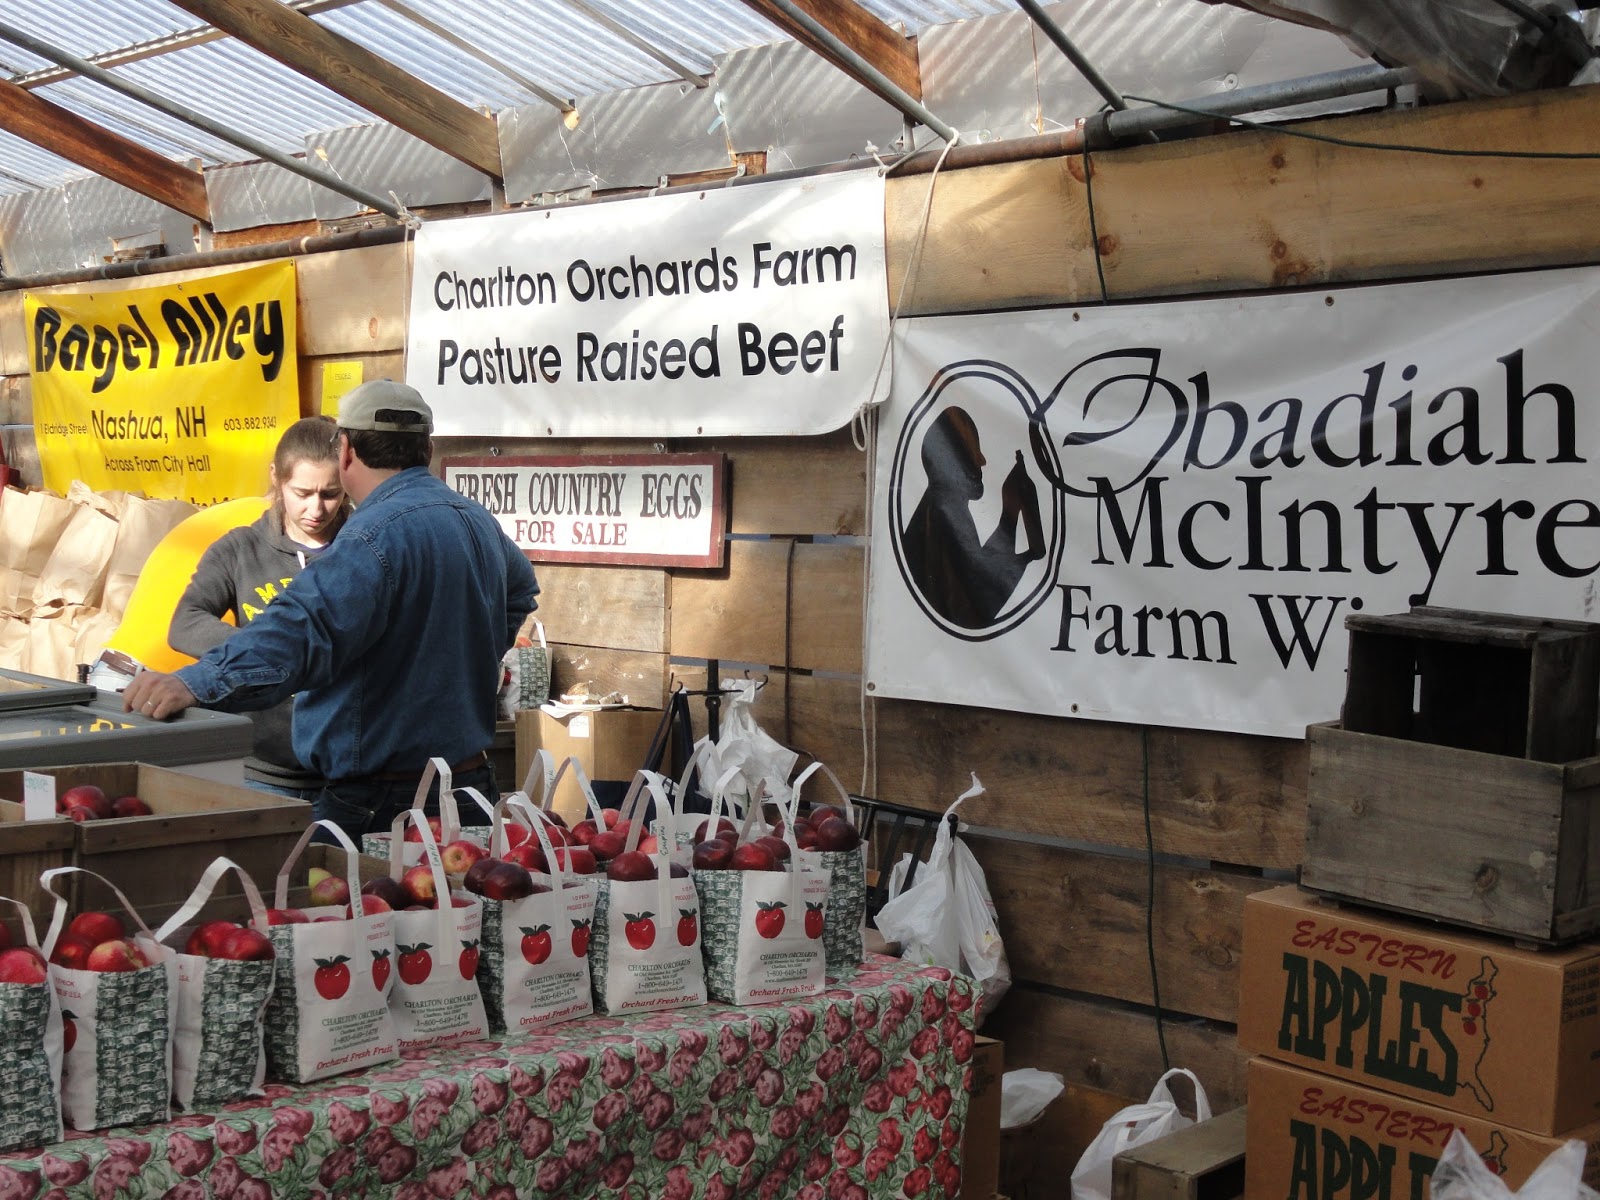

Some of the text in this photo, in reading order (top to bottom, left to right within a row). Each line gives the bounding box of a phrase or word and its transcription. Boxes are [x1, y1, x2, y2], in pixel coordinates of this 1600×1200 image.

[434, 242, 857, 312] Charlton Orchards Farm
[34, 292, 285, 393] Bagel Alley
[437, 315, 845, 385] Pasture Raised Beef
[69, 423, 88, 435] Street
[91, 410, 168, 444] Nashua,
[176, 406, 207, 438] NH
[1029, 347, 1588, 498] Obadiah
[105, 455, 211, 476] Across From City Hall
[455, 472, 703, 520] FRESH COUNTRY EGGS
[515, 519, 628, 546] FOR SALE
[1087, 475, 1600, 607] McIntyre
[1050, 584, 1364, 672] Farm W
[660, 825, 669, 856] Empire
[628, 964, 662, 972] CHARLTON
[1292, 920, 1456, 980] EASTERN
[405, 998, 442, 1008] CHARLTON
[621, 992, 699, 1009] Orchard Fresh Fruit
[749, 984, 816, 997] Orchard Fresh Fruit
[520, 1002, 589, 1025] Orchard Fresh Fruit
[1278, 952, 1463, 1097] APPLES
[397, 1037, 434, 1047] Orchard
[435, 1032, 459, 1042] Fresh
[459, 1027, 482, 1037] Fruit
[316, 1045, 394, 1070] Orchard Fresh Fruit
[1287, 1119, 1440, 1200] APP
